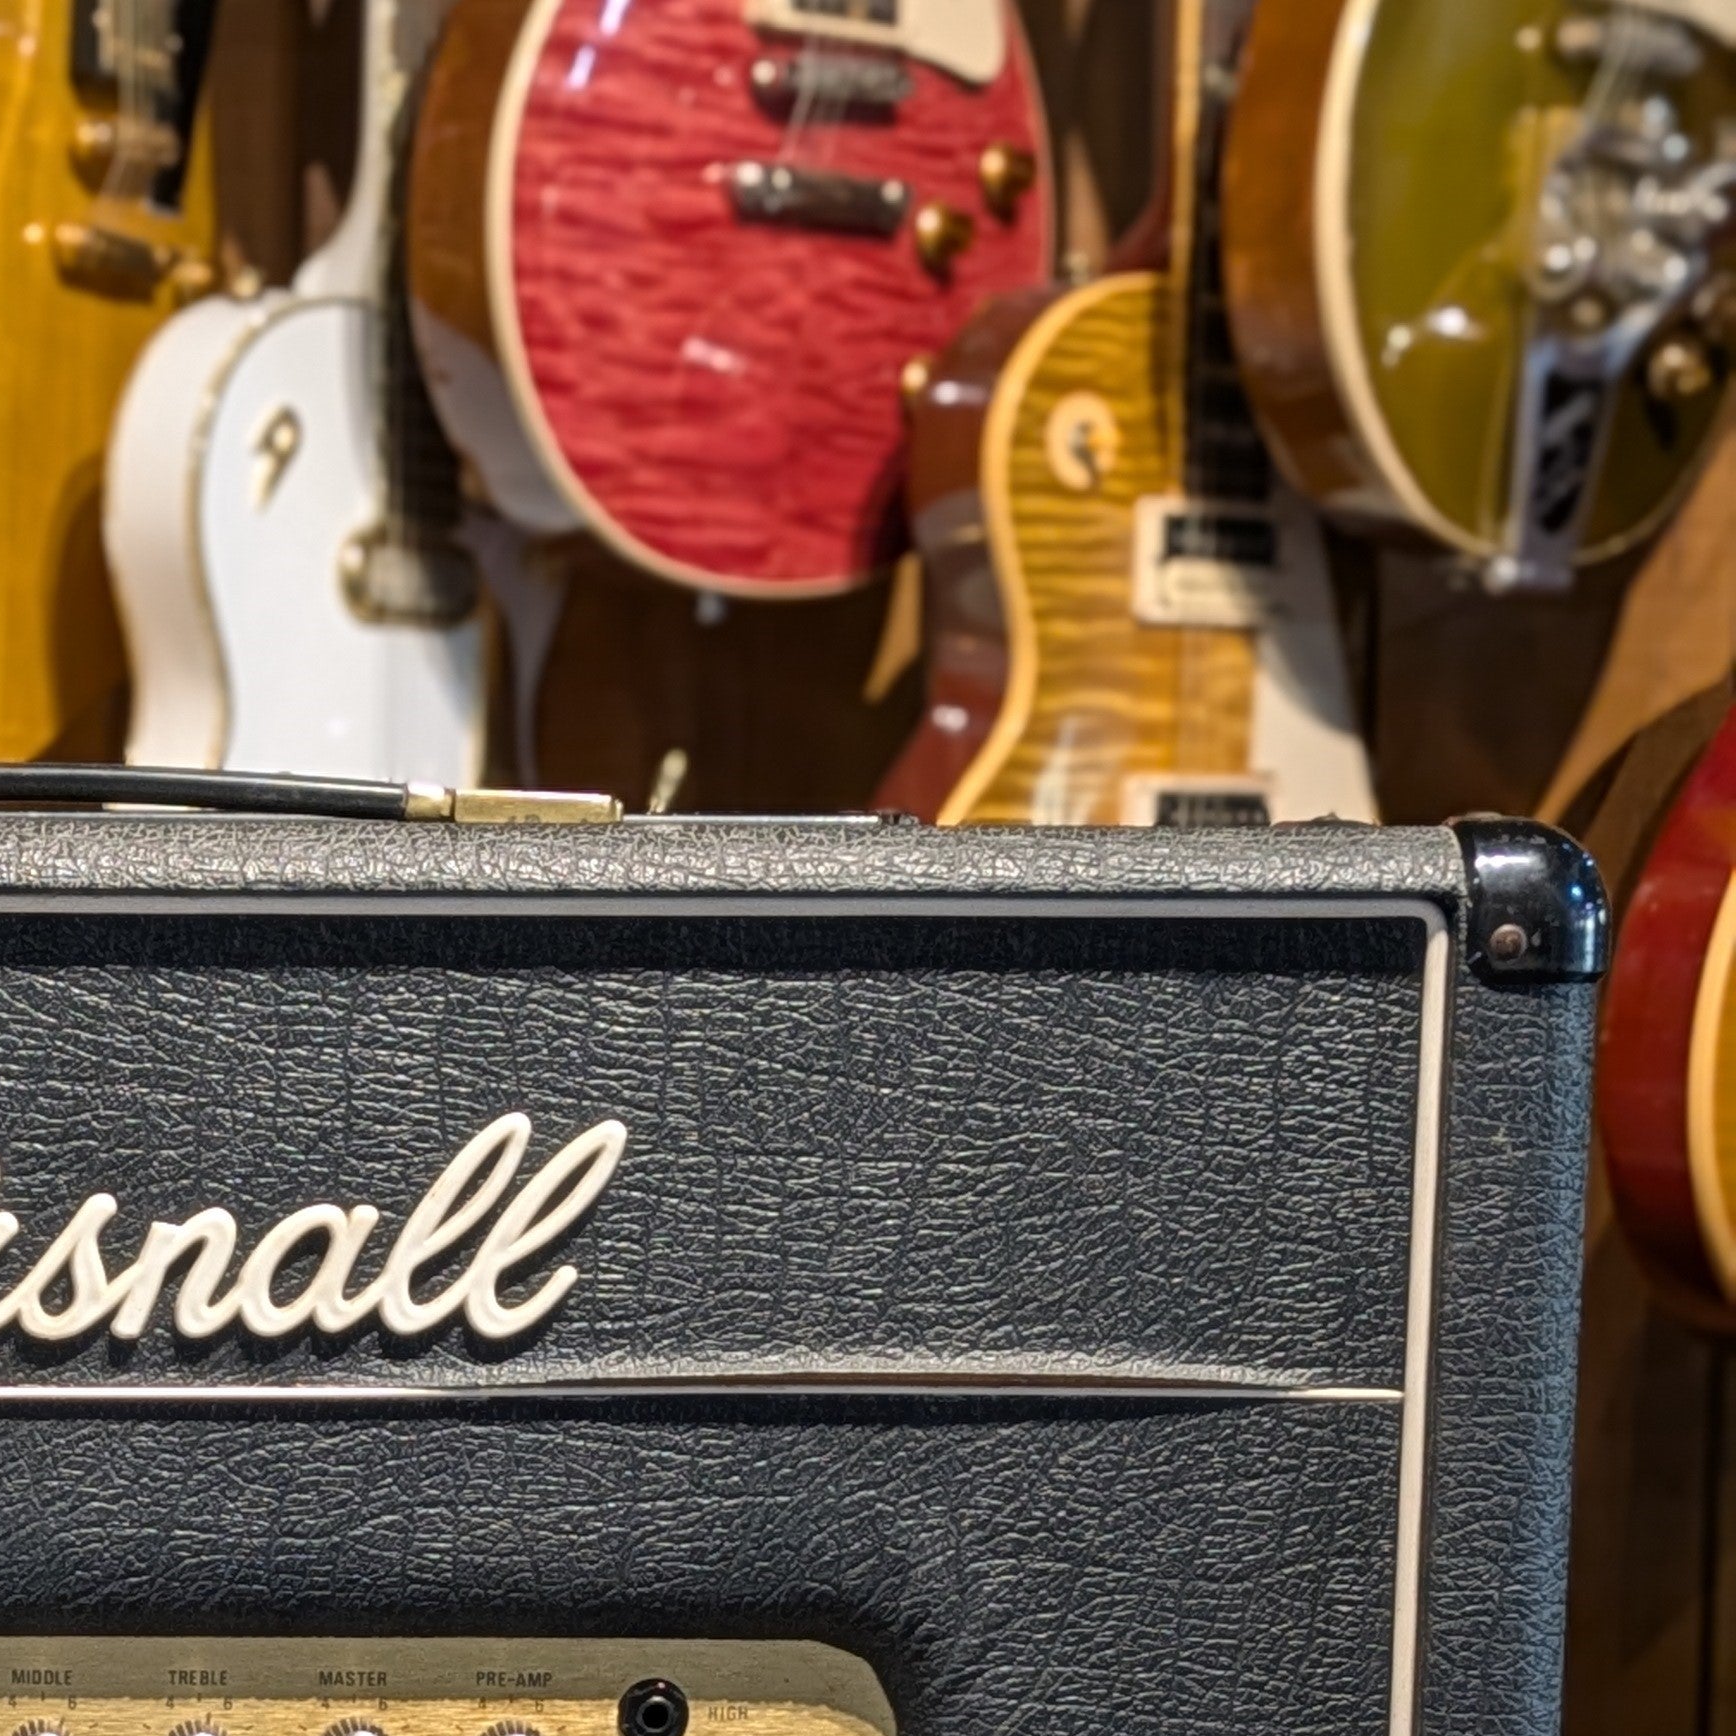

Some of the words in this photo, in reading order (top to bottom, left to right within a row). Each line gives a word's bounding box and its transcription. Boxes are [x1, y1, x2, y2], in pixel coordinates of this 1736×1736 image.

[11, 1669, 73, 1686] MIDDLE
[168, 1669, 228, 1686] TREBLE
[319, 1671, 387, 1687] MASTER
[476, 1672, 552, 1688] PRE-AMP
[68, 1694, 77, 1710] 6
[223, 1695, 232, 1710] 6
[378, 1695, 388, 1711] 6
[535, 1697, 544, 1713] 6
[708, 1705, 749, 1720] HIGH
